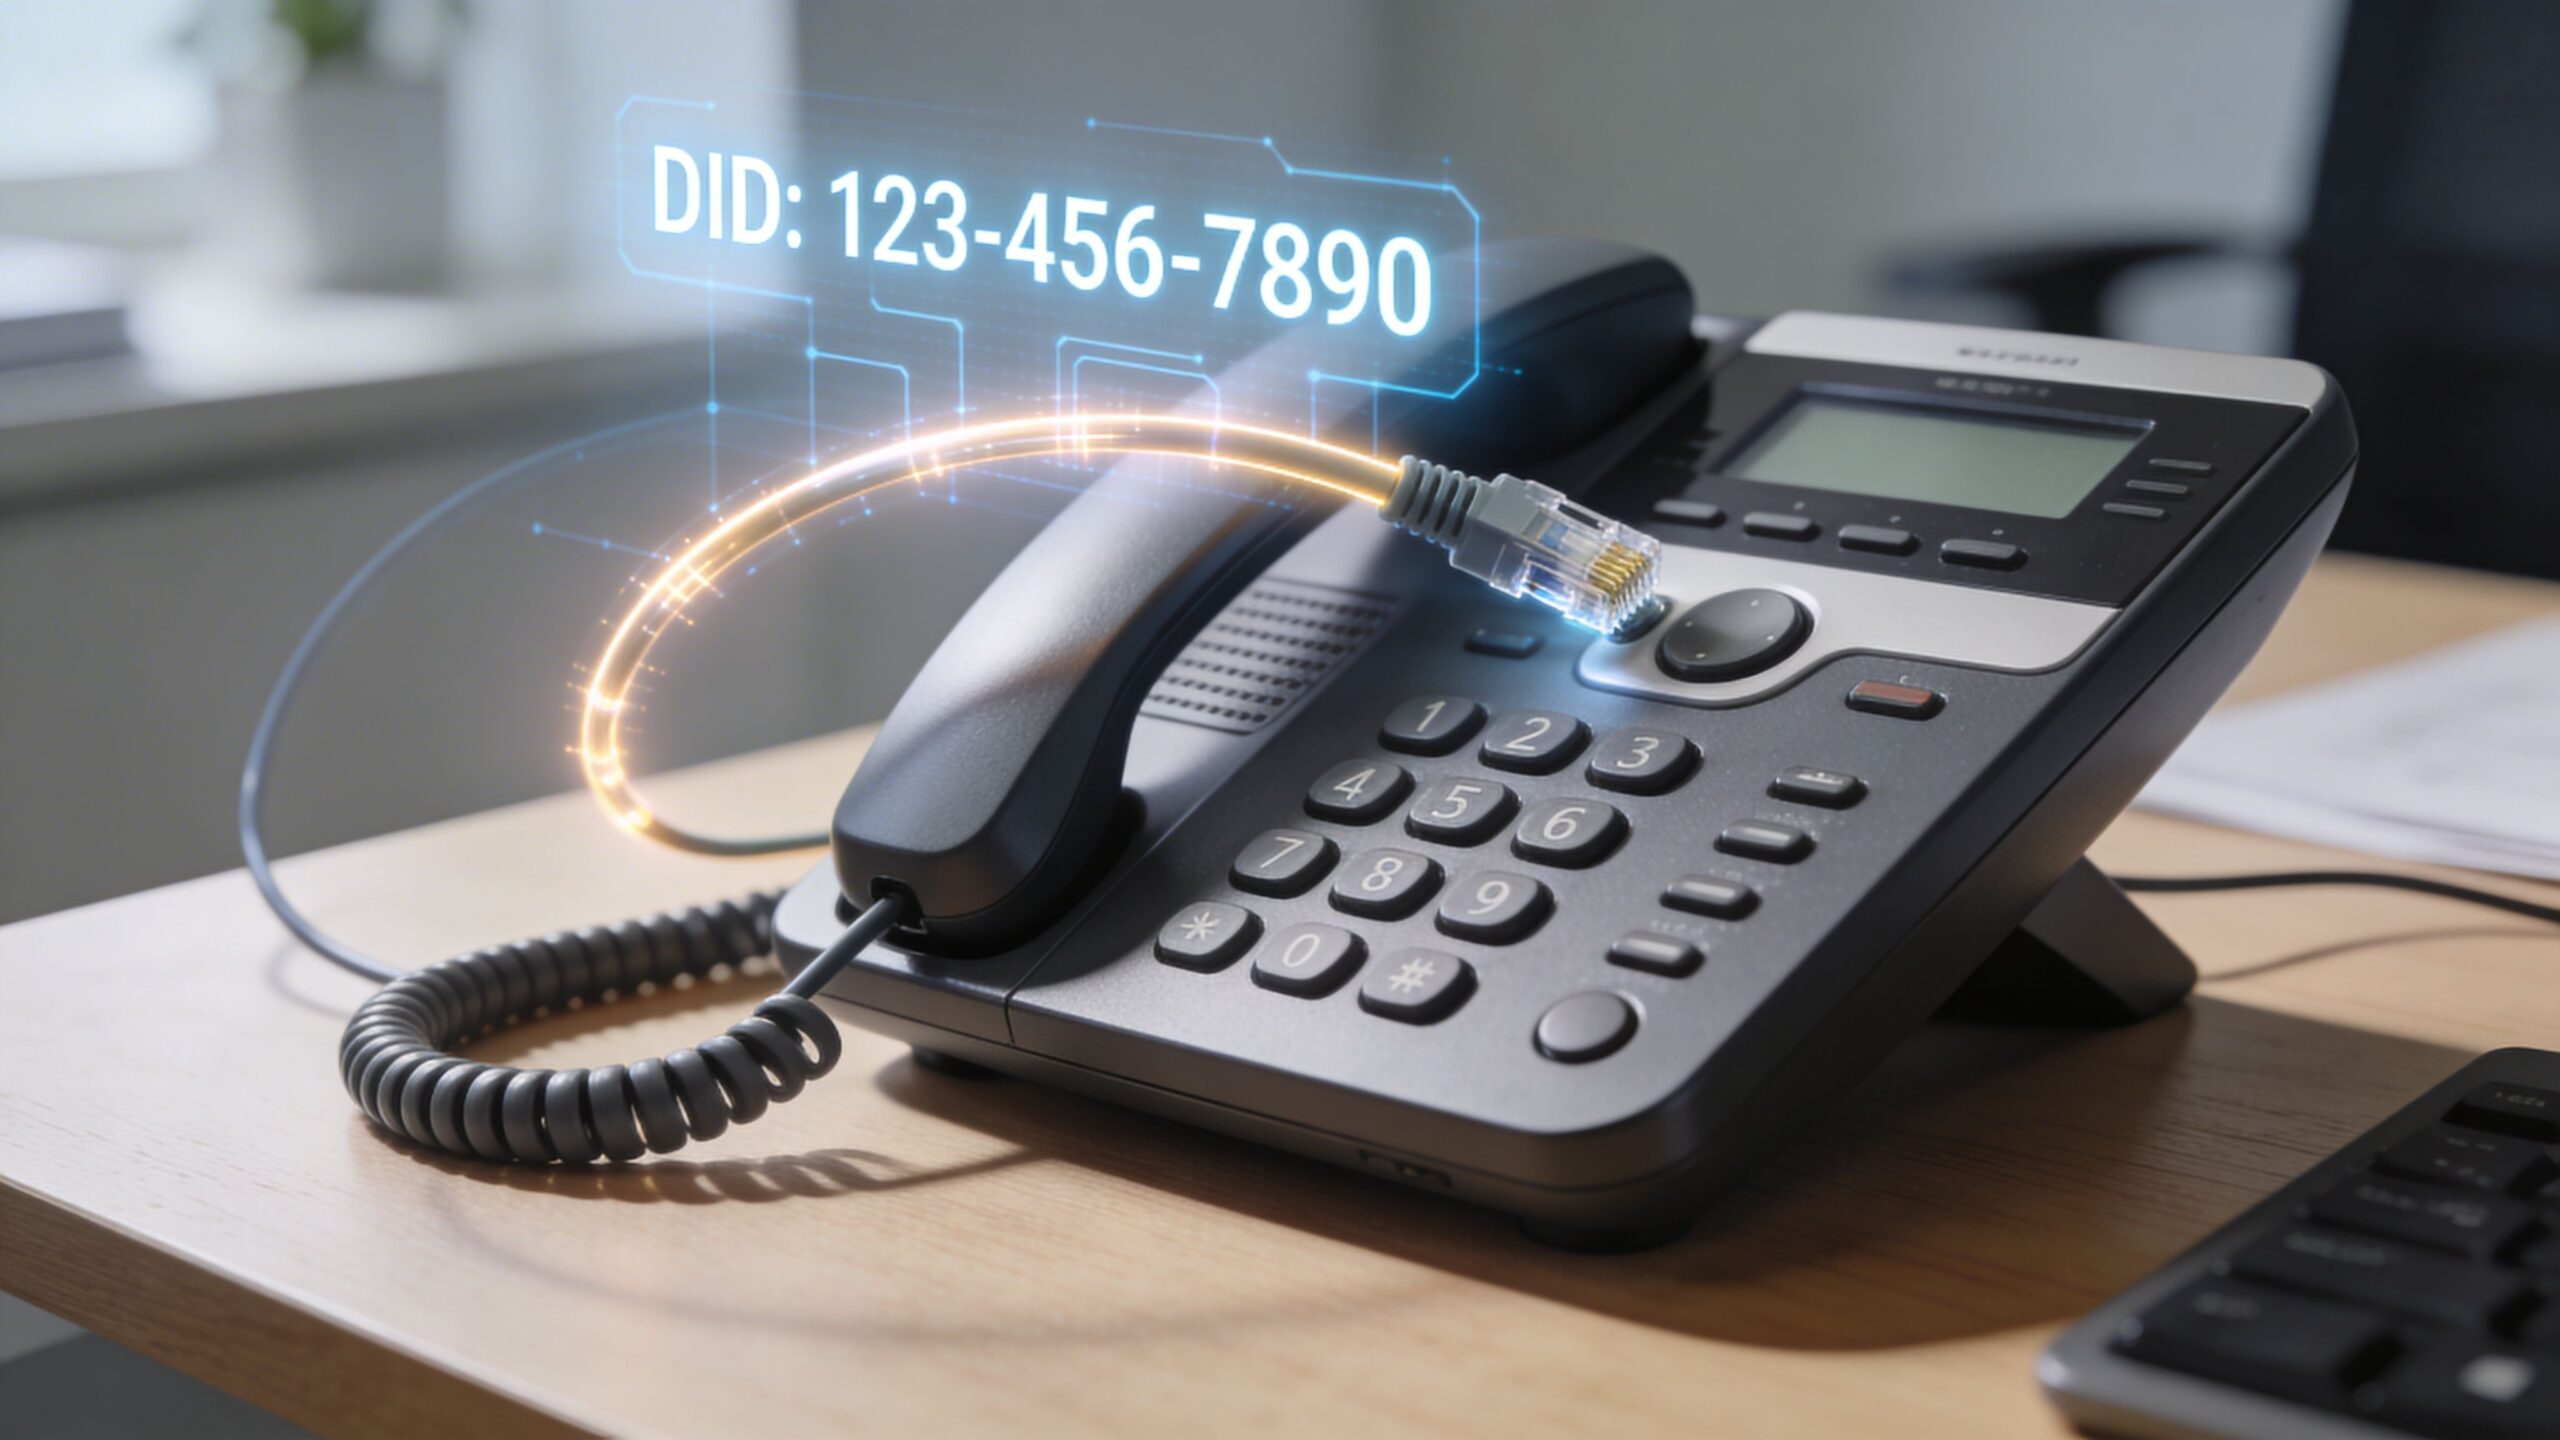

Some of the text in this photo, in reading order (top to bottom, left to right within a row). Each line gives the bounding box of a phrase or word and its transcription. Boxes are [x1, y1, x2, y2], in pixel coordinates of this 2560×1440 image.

[1416, 701, 1446, 732] 1
[1505, 716, 1552, 751] 2
[1616, 735, 1660, 769] 3
[1333, 767, 1377, 801] 4
[1430, 784, 1482, 820] 5
[1543, 806, 1587, 840] 6
[1260, 836, 1306, 869] 7
[1360, 856, 1404, 892] 8
[1467, 880, 1511, 917] 9
[1282, 932, 1321, 968] 0
[1388, 957, 1436, 994] #
